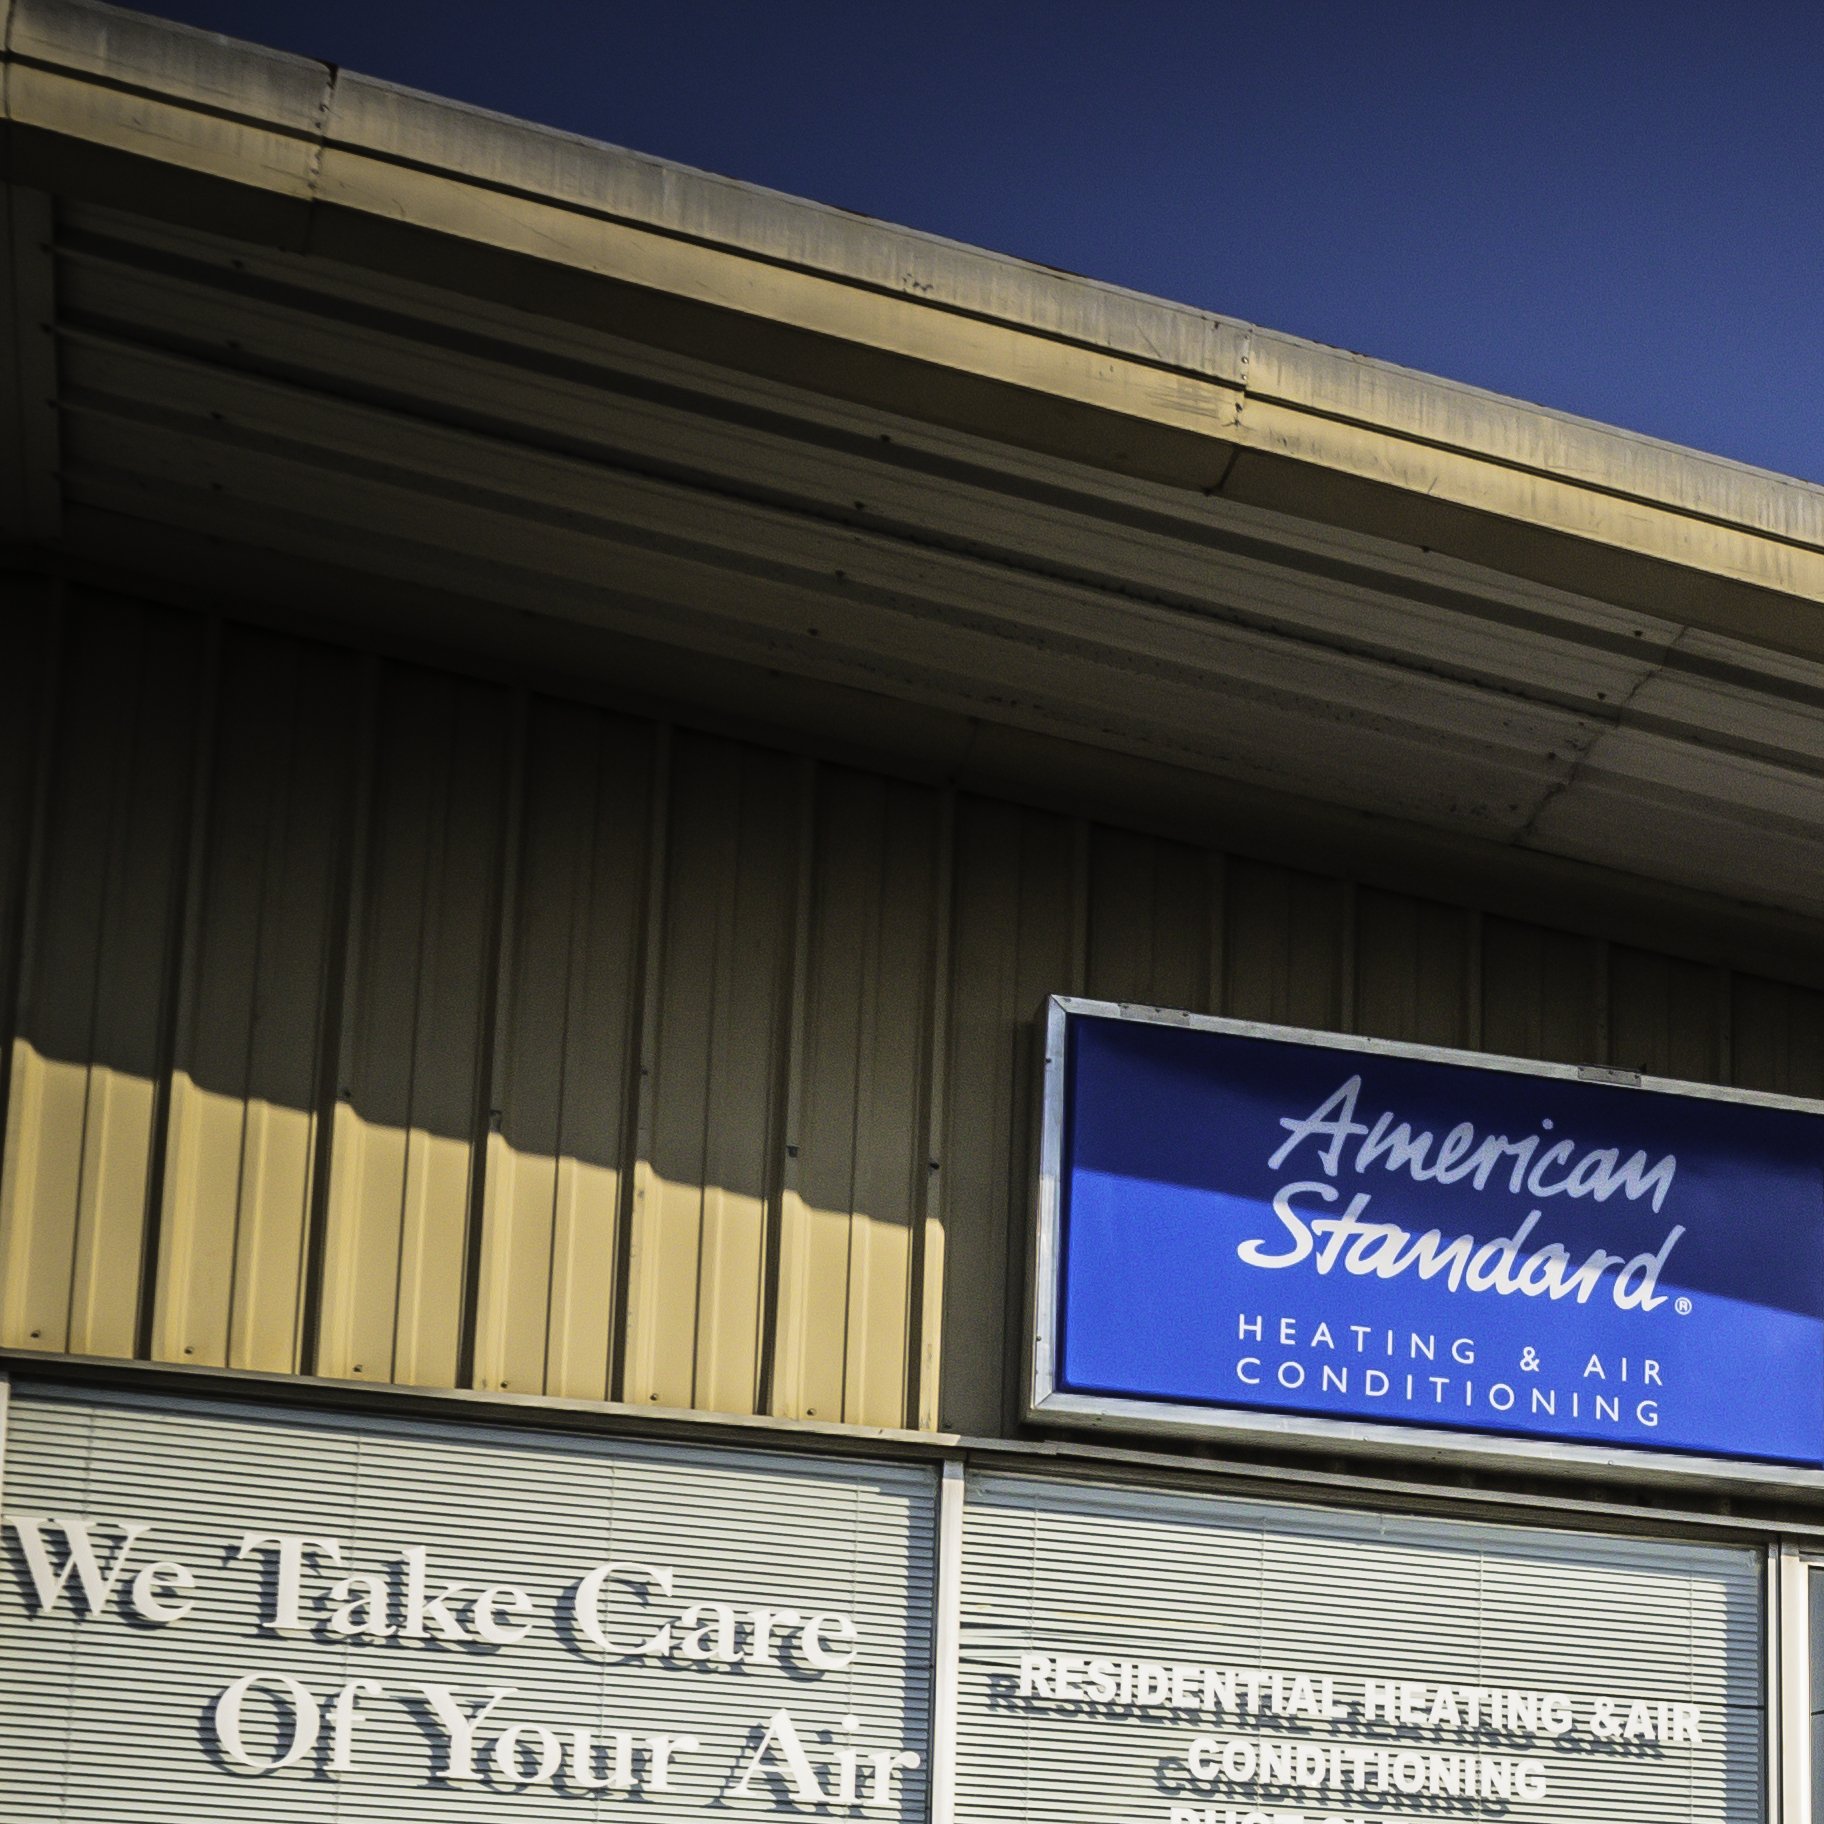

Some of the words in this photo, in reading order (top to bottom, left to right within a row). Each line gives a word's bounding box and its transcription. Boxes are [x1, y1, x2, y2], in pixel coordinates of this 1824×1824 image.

[1267, 1075, 1677, 1213] American
[1237, 1182, 1686, 1313] Standard
[1236, 1357, 1660, 1428] CONDITIONING
[1239, 1314, 1476, 1365] HEATING
[1520, 1347, 1541, 1372] &
[1585, 1354, 1663, 1386] AIR
[3, 1516, 196, 1625] We
[236, 1532, 534, 1645] Take
[574, 1561, 858, 1672] Care
[213, 1672, 383, 1777] Of
[408, 1682, 699, 1794] Your
[727, 1707, 921, 1808] Air
[1017, 1654, 1347, 1721] RESIDENTIAL
[1365, 1674, 1573, 1735] HEATING
[1188, 1737, 1547, 1800] CONDITIONING
